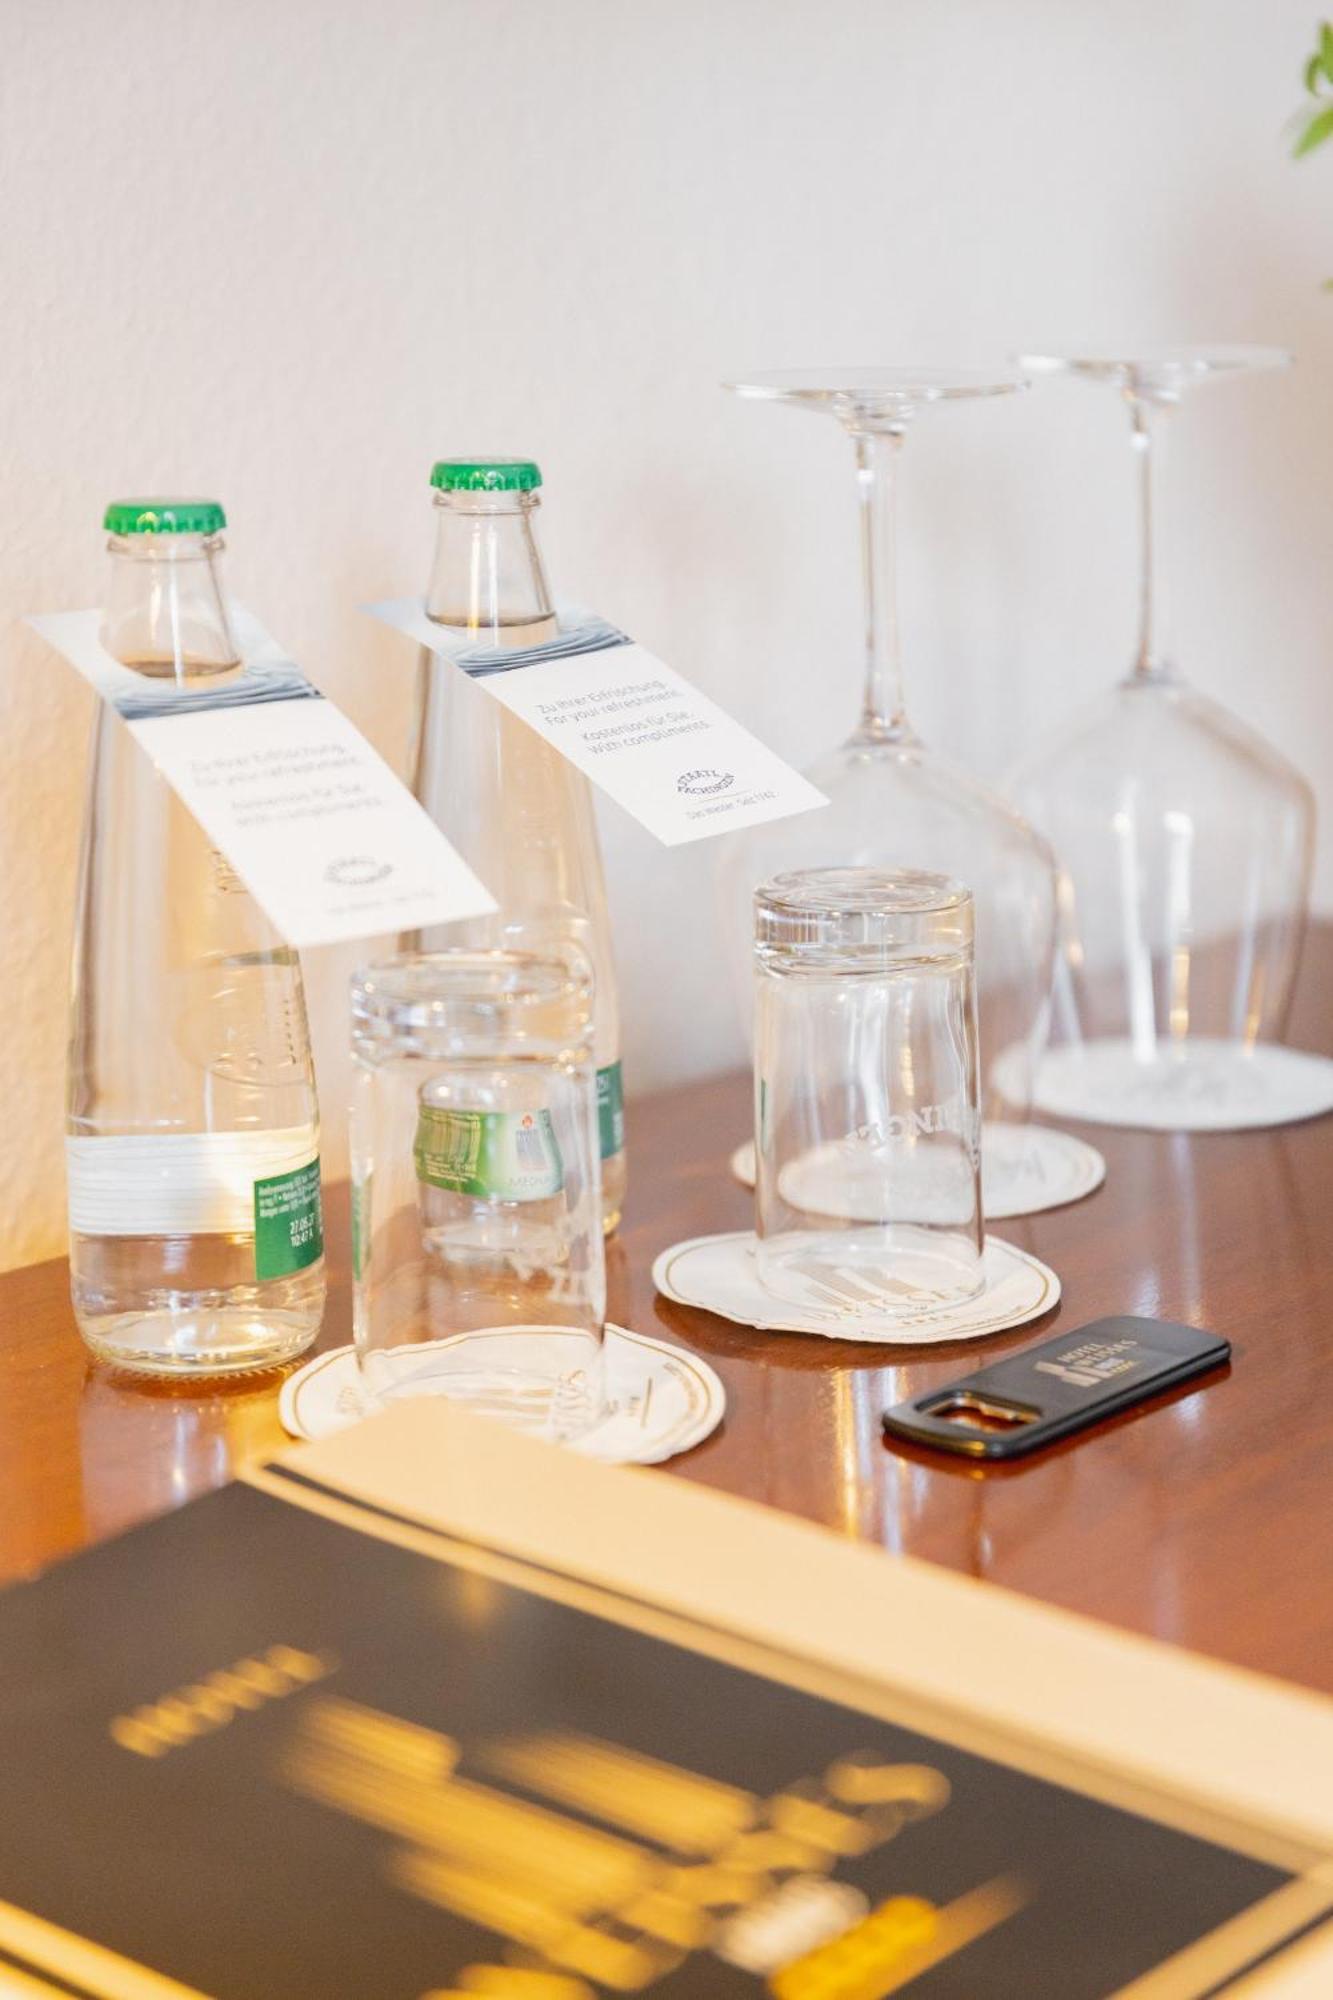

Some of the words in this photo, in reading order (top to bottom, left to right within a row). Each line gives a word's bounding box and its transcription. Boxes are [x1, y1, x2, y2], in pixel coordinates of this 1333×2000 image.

[536, 703, 557, 714] Zu
[543, 713, 571, 726] For
[584, 740, 621, 754] With
